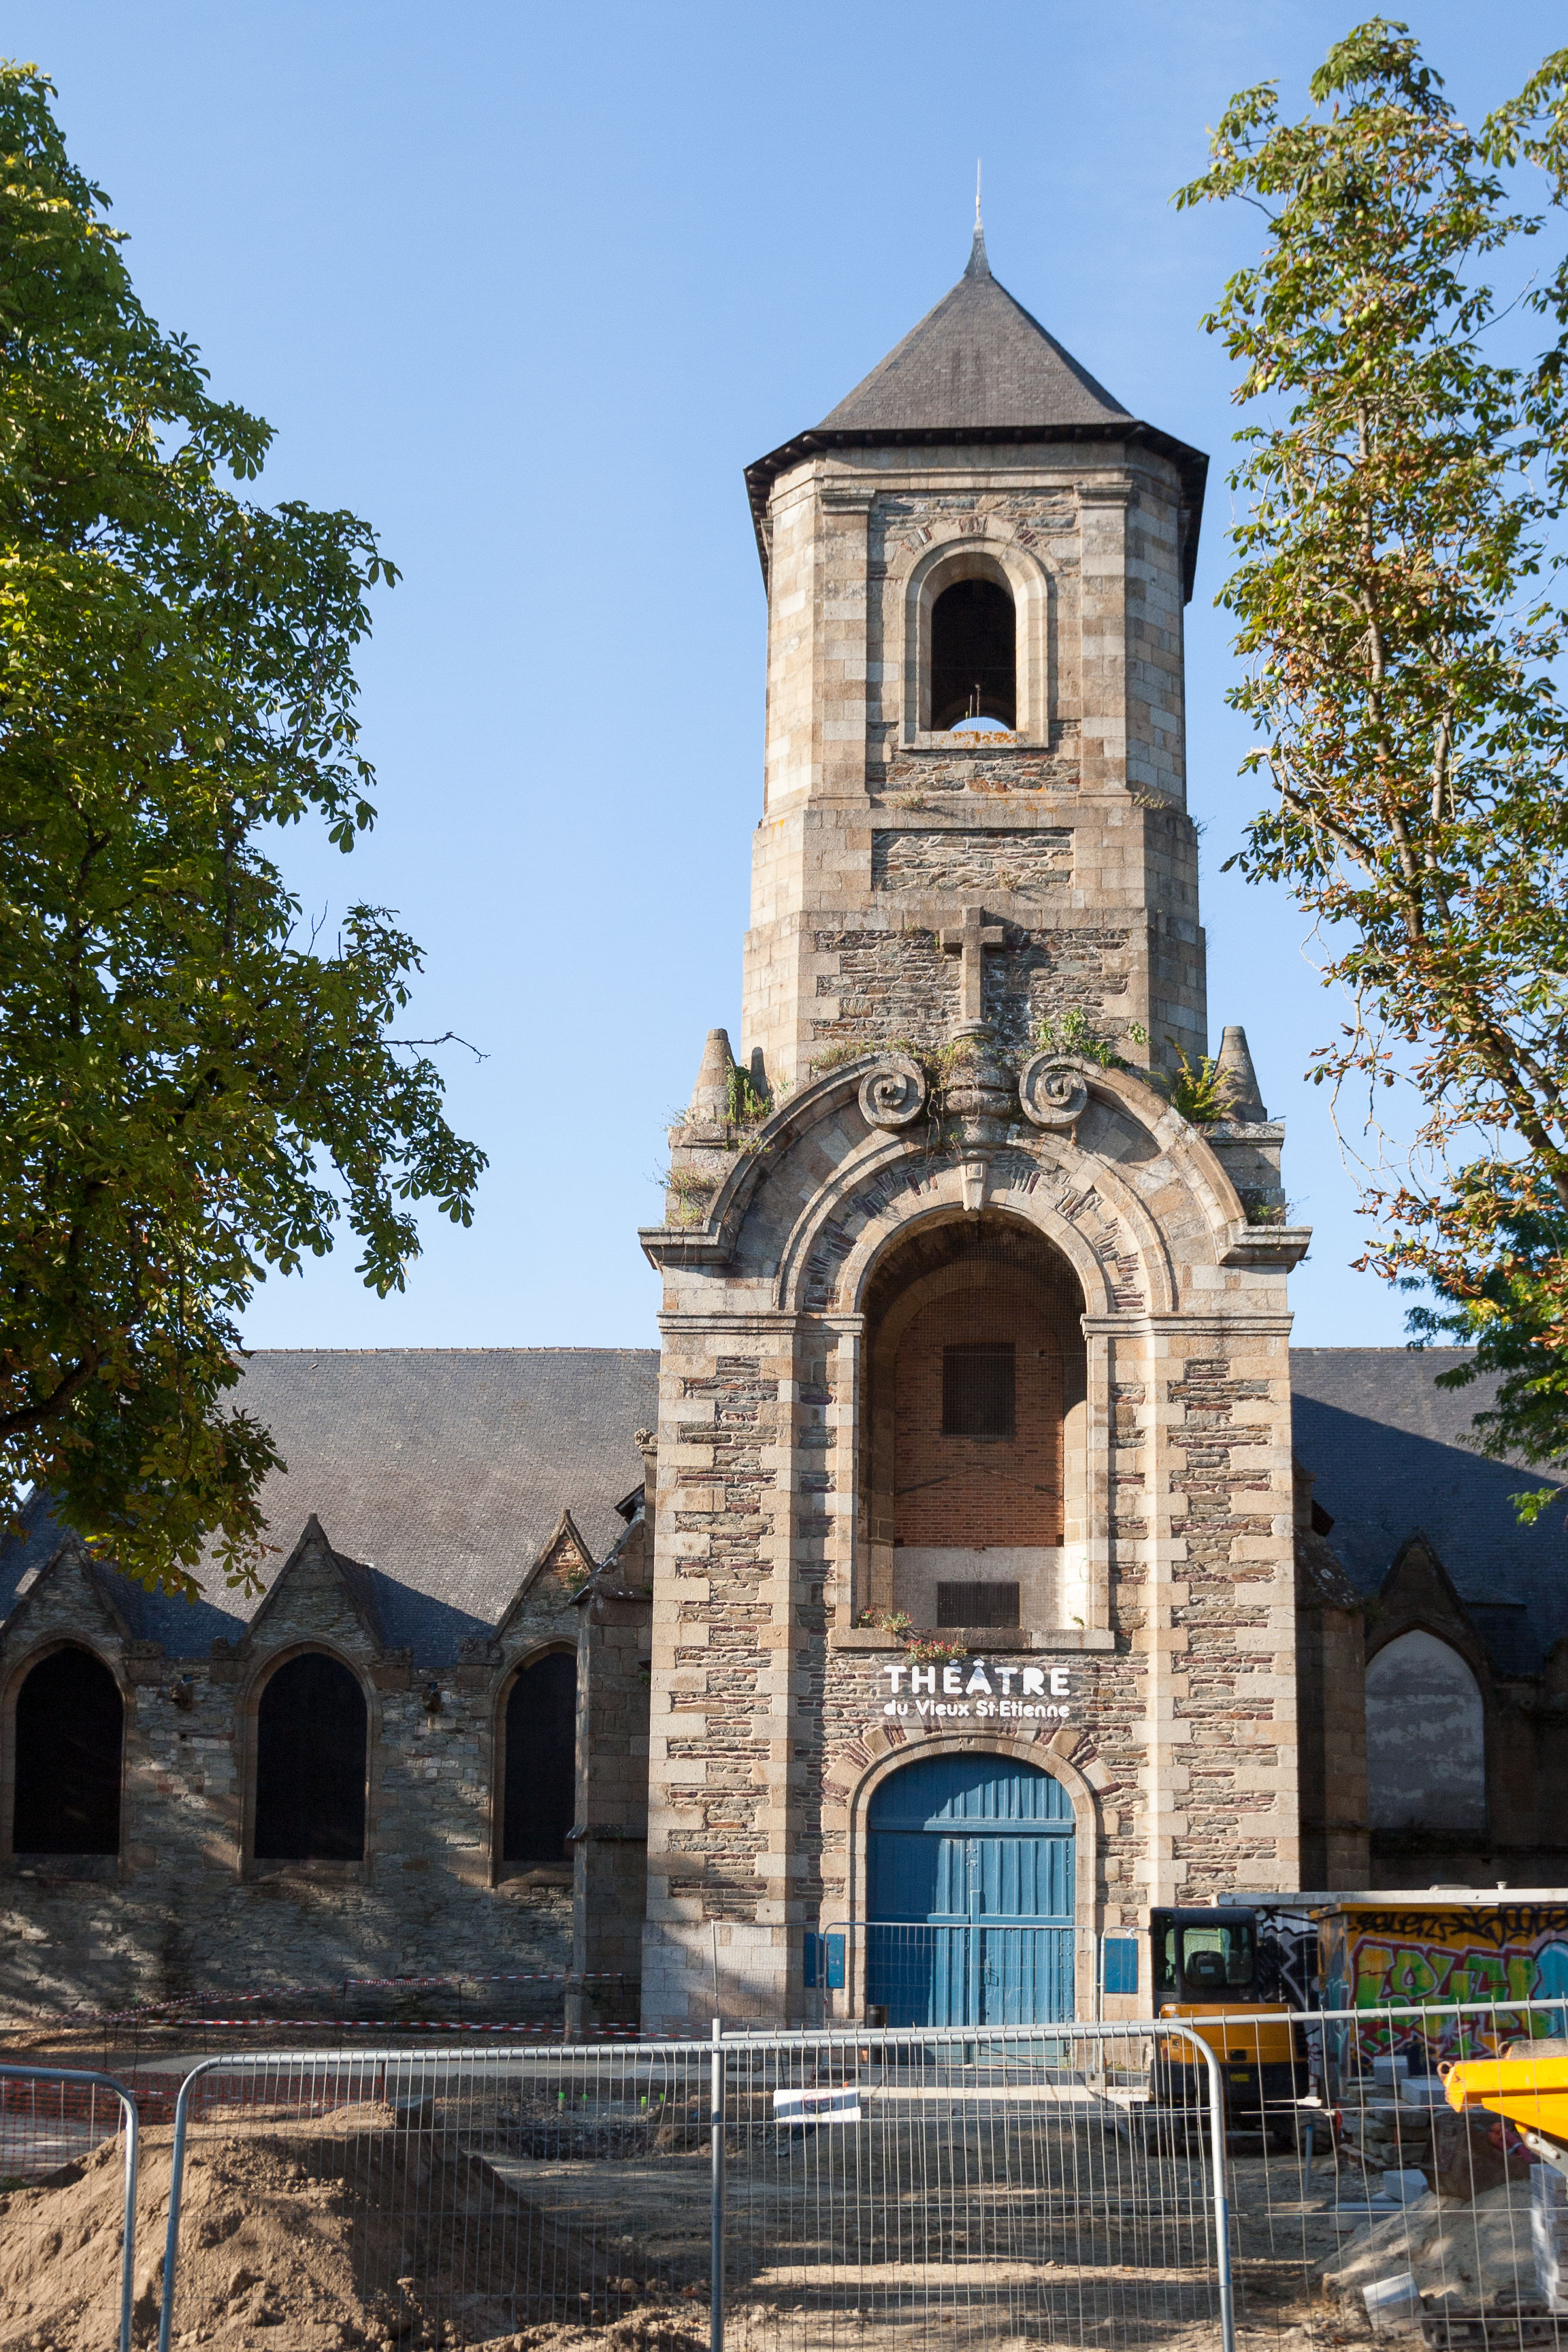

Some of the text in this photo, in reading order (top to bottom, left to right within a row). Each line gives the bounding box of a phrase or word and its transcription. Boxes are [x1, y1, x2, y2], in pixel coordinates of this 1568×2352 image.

[883, 1659, 1070, 1696] THÉÂTRE
[884, 1699, 1070, 1718] du Vieux St-Etienne
